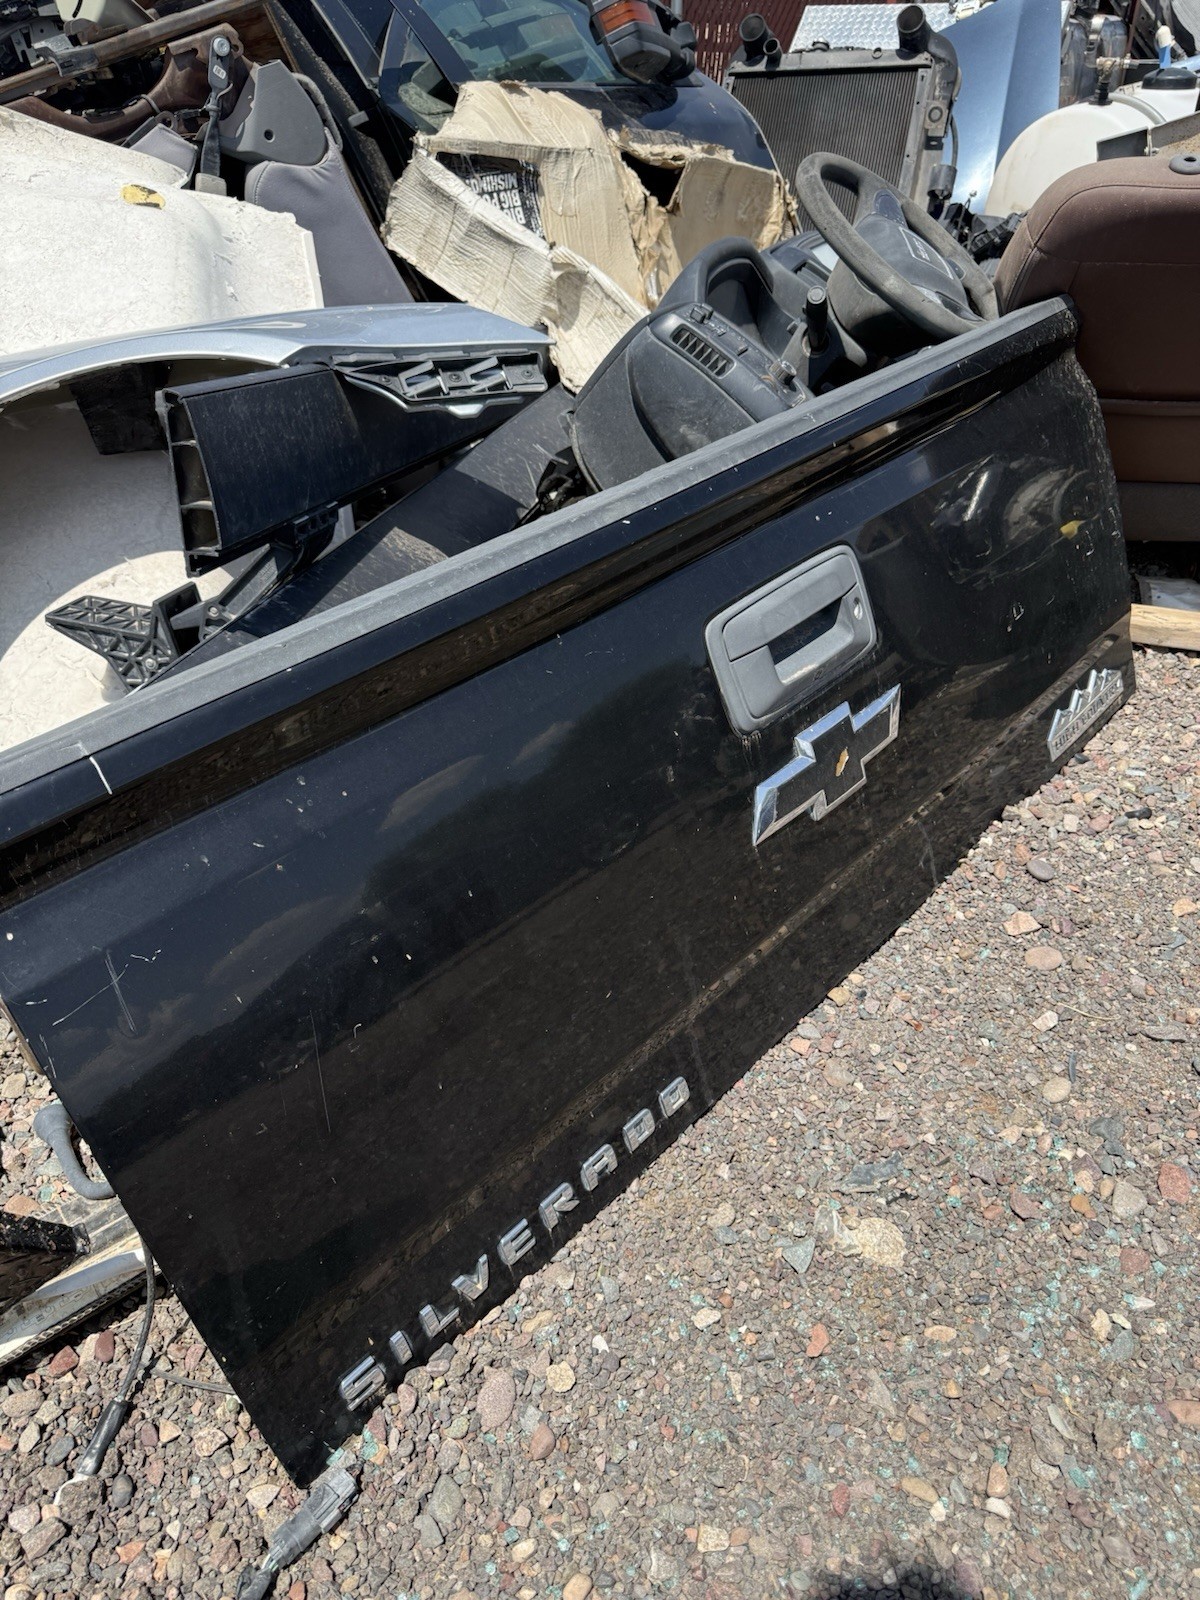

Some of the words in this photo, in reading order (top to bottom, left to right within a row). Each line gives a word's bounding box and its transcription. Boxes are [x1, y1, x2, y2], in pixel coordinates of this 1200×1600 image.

[466, 172, 518, 194] MISHIMO
[501, 189, 522, 209] BIG
[339, 1076, 691, 1411] SILVERADO
